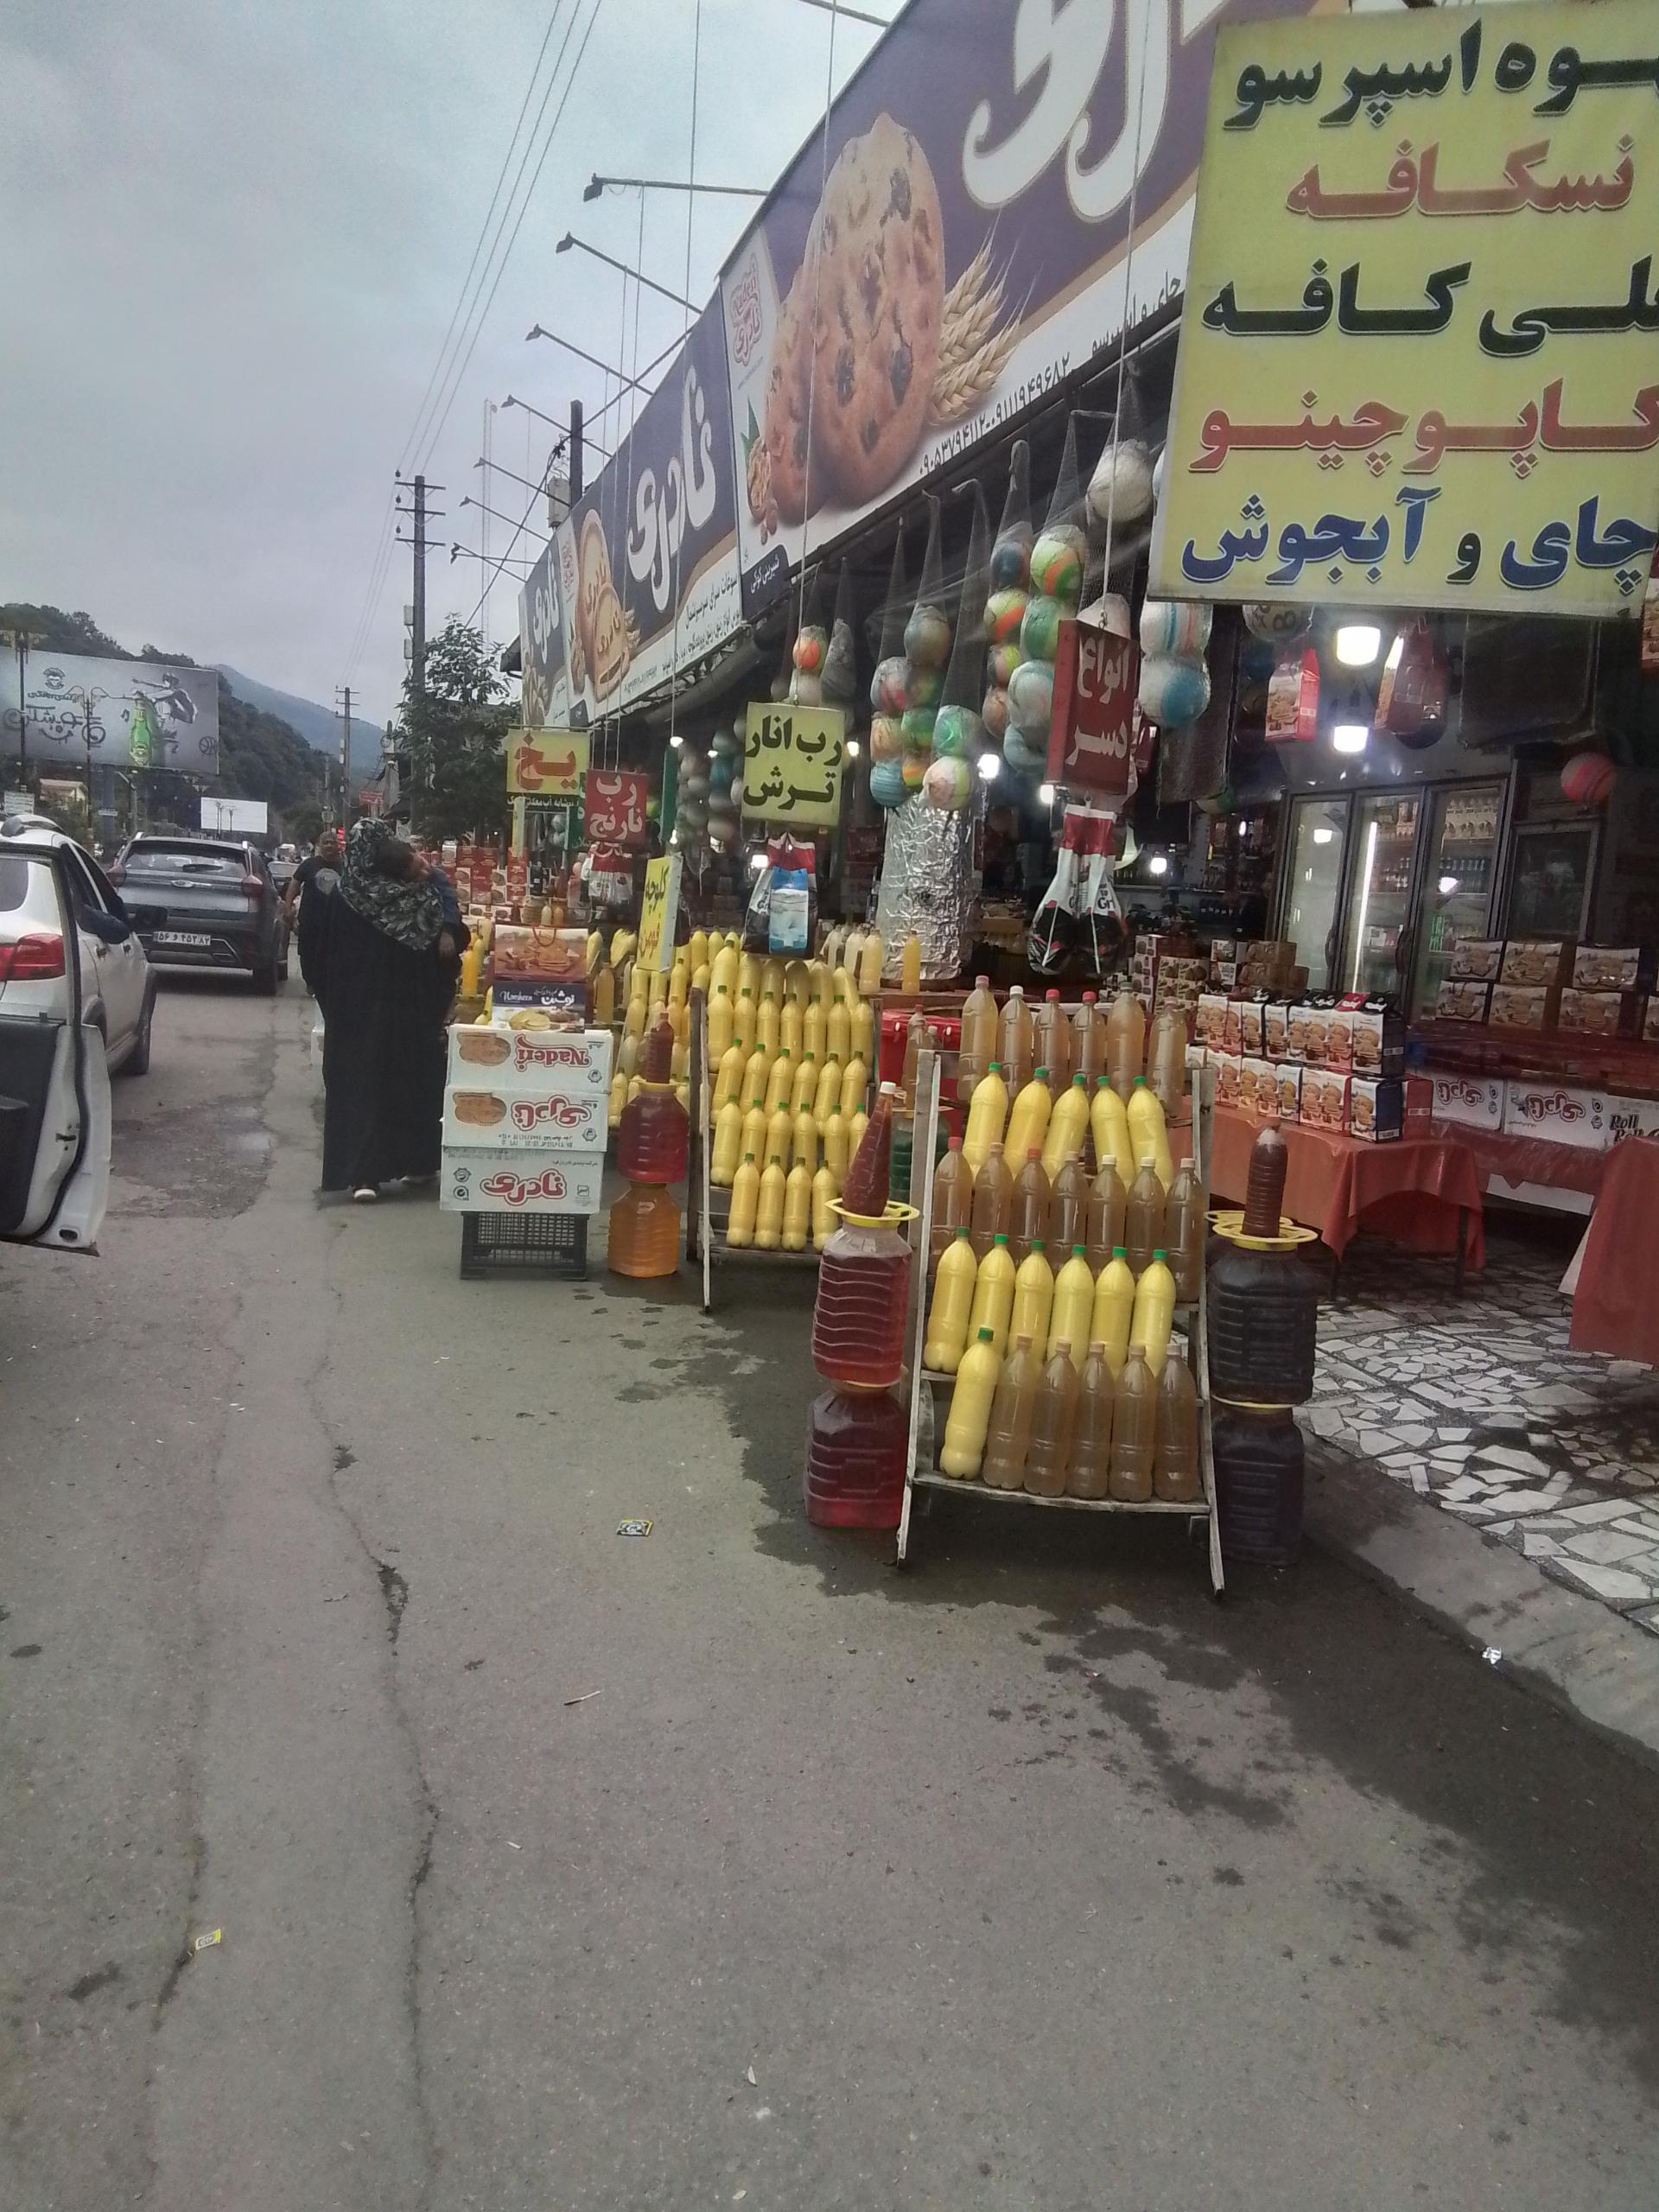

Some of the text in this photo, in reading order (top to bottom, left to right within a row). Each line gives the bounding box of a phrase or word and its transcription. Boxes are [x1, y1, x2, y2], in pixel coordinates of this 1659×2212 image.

[1224, 19, 1483, 129] اسپرسو
[1286, 134, 1636, 218] نسکافه
[1202, 255, 1659, 357] لی کافه
[1189, 378, 1659, 477] کاپوچینو
[627, 364, 717, 614] نادری
[1180, 486, 1657, 595] چای و آبجوش
[1077, 635, 1128, 704] انواع
[513, 733, 578, 791] یخ
[745, 715, 842, 766] رب انار
[1065, 721, 1127, 766] دسر
[596, 775, 637, 806] رب
[743, 766, 836, 810] ترش
[589, 804, 643, 840] نارنج
[516, 1034, 593, 1071] Naderi
[512, 1096, 591, 1131] نادری
[1525, 1090, 1586, 1122] نادری
[480, 1169, 567, 1205] نادری
